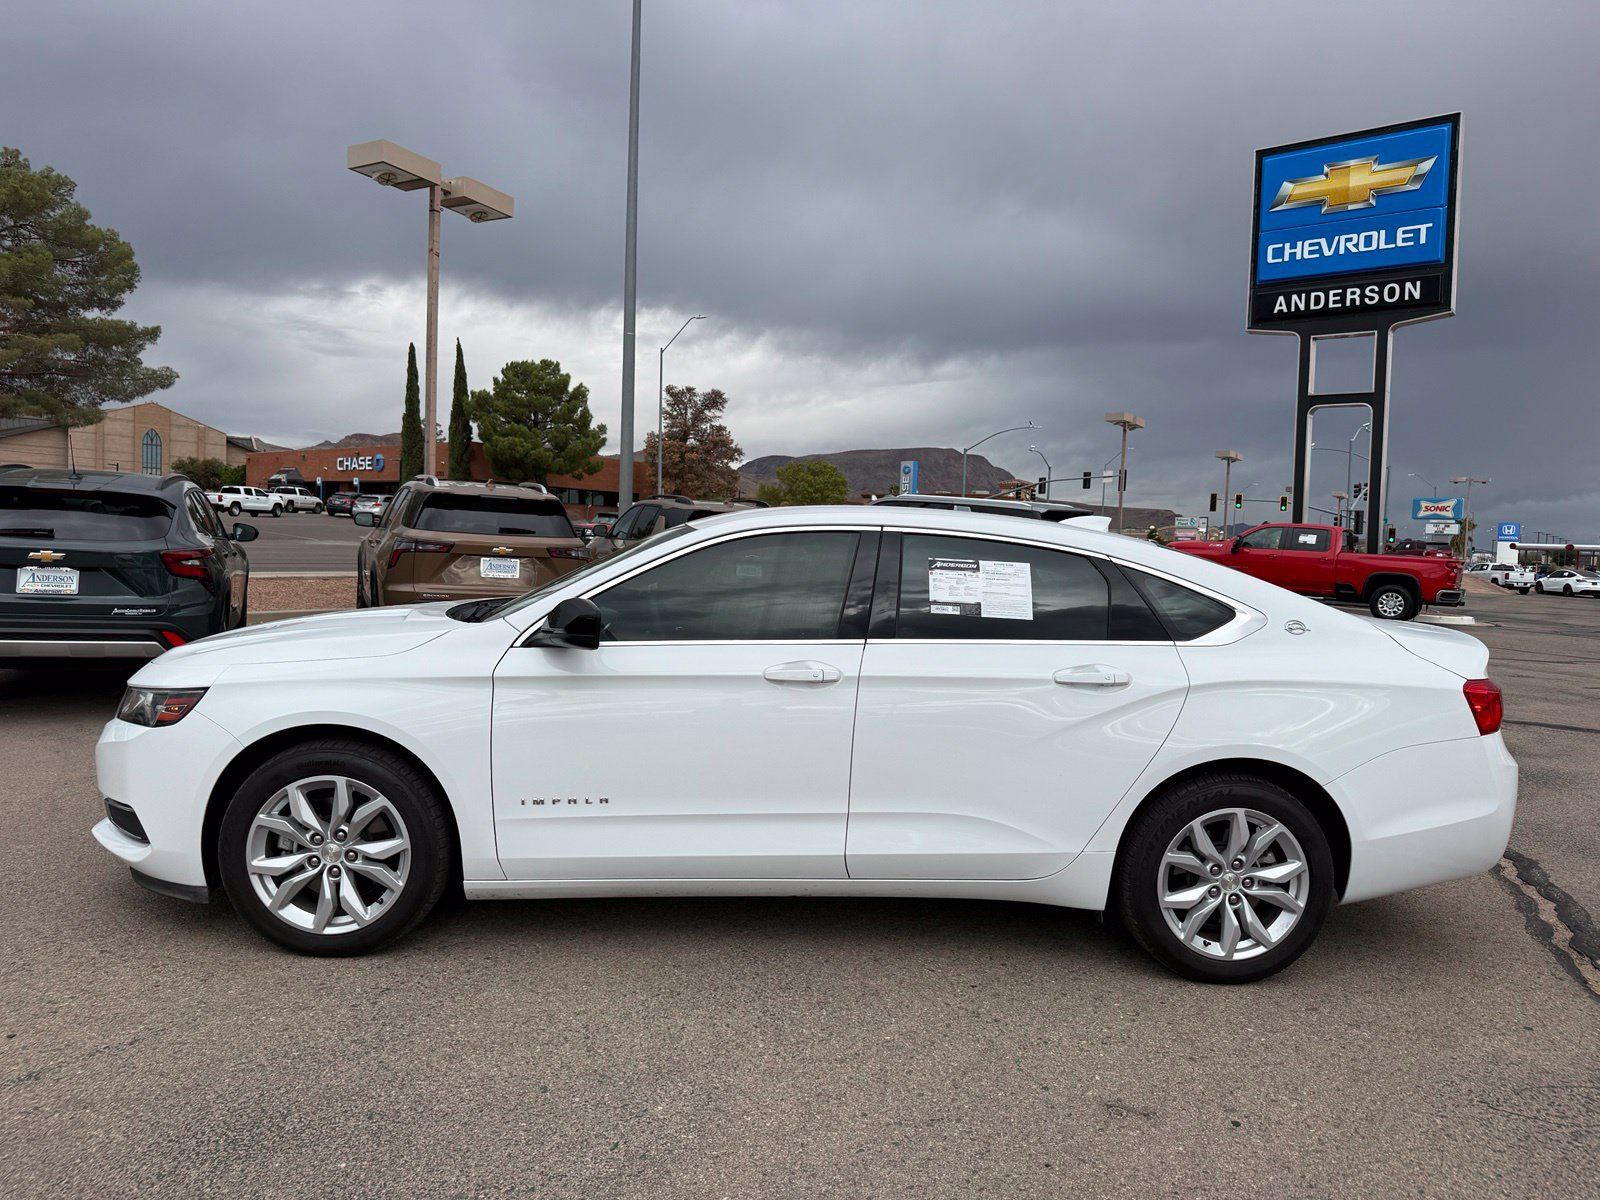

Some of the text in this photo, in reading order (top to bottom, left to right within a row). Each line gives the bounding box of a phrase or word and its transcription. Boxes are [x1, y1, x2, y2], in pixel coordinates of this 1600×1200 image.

[1266, 223, 1433, 264] CHEVROLET
[1273, 280, 1421, 314] ANDERSON
[336, 456, 373, 471] CHASE
[22, 573, 75, 587] ANDERSON
[521, 797, 609, 806] IMPALA
